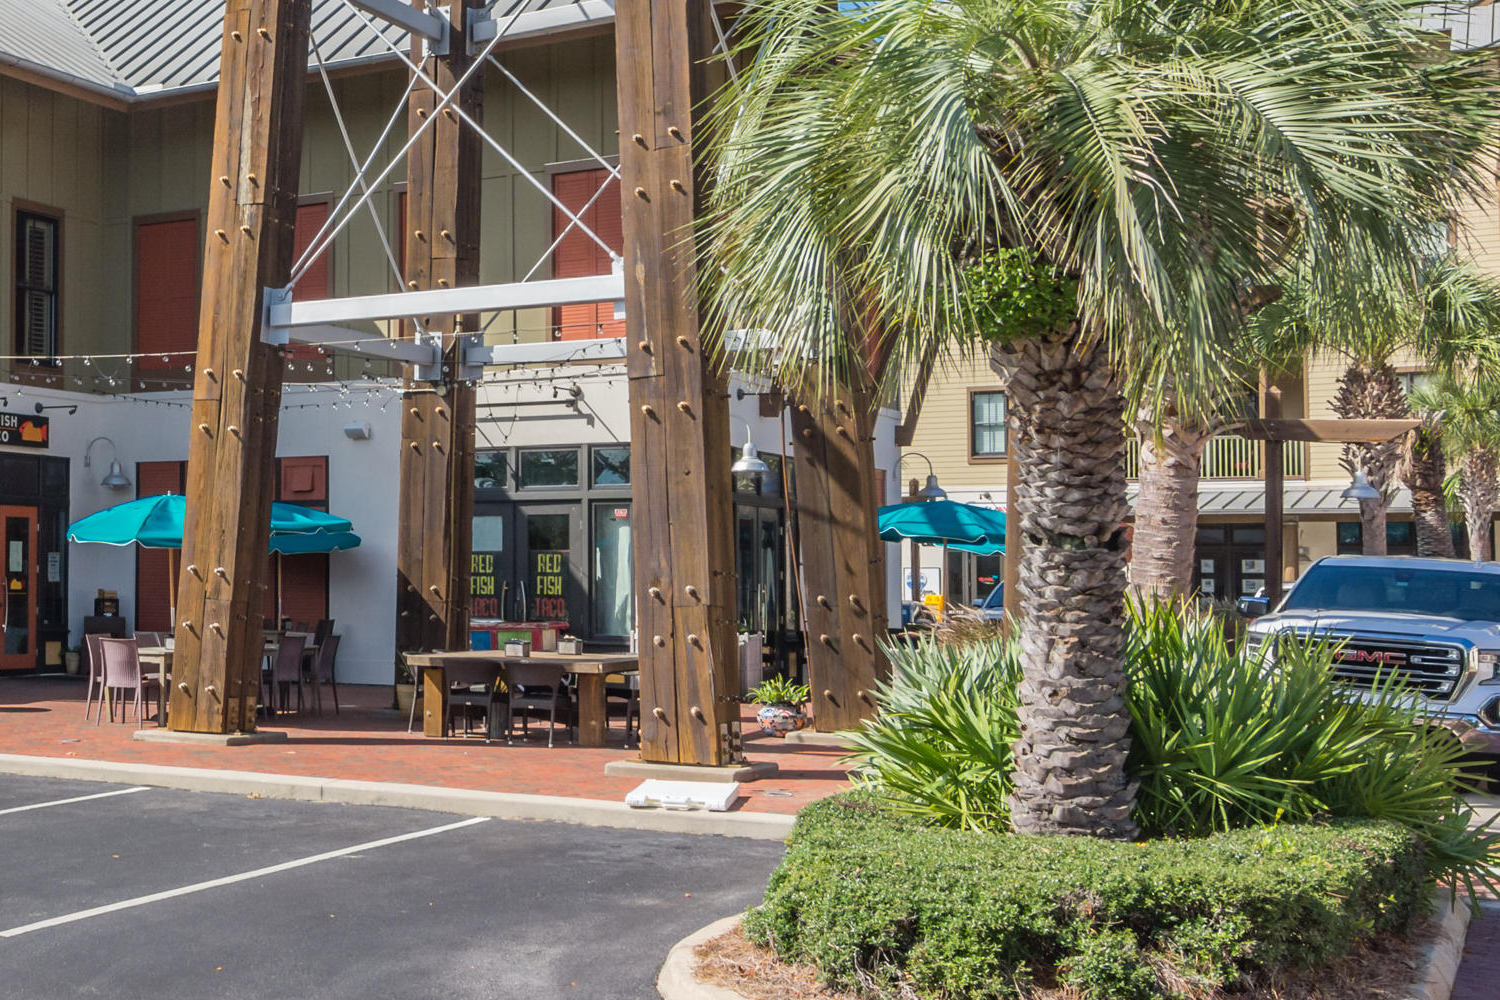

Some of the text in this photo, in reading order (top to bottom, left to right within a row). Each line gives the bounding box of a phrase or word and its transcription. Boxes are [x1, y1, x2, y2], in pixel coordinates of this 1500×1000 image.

[471, 554, 494, 573] RED
[537, 553, 562, 573] RED
[470, 576, 495, 595] FISH
[536, 576, 562, 595] FISH
[535, 597, 565, 616] TACO
[1335, 649, 1407, 664] GMC
